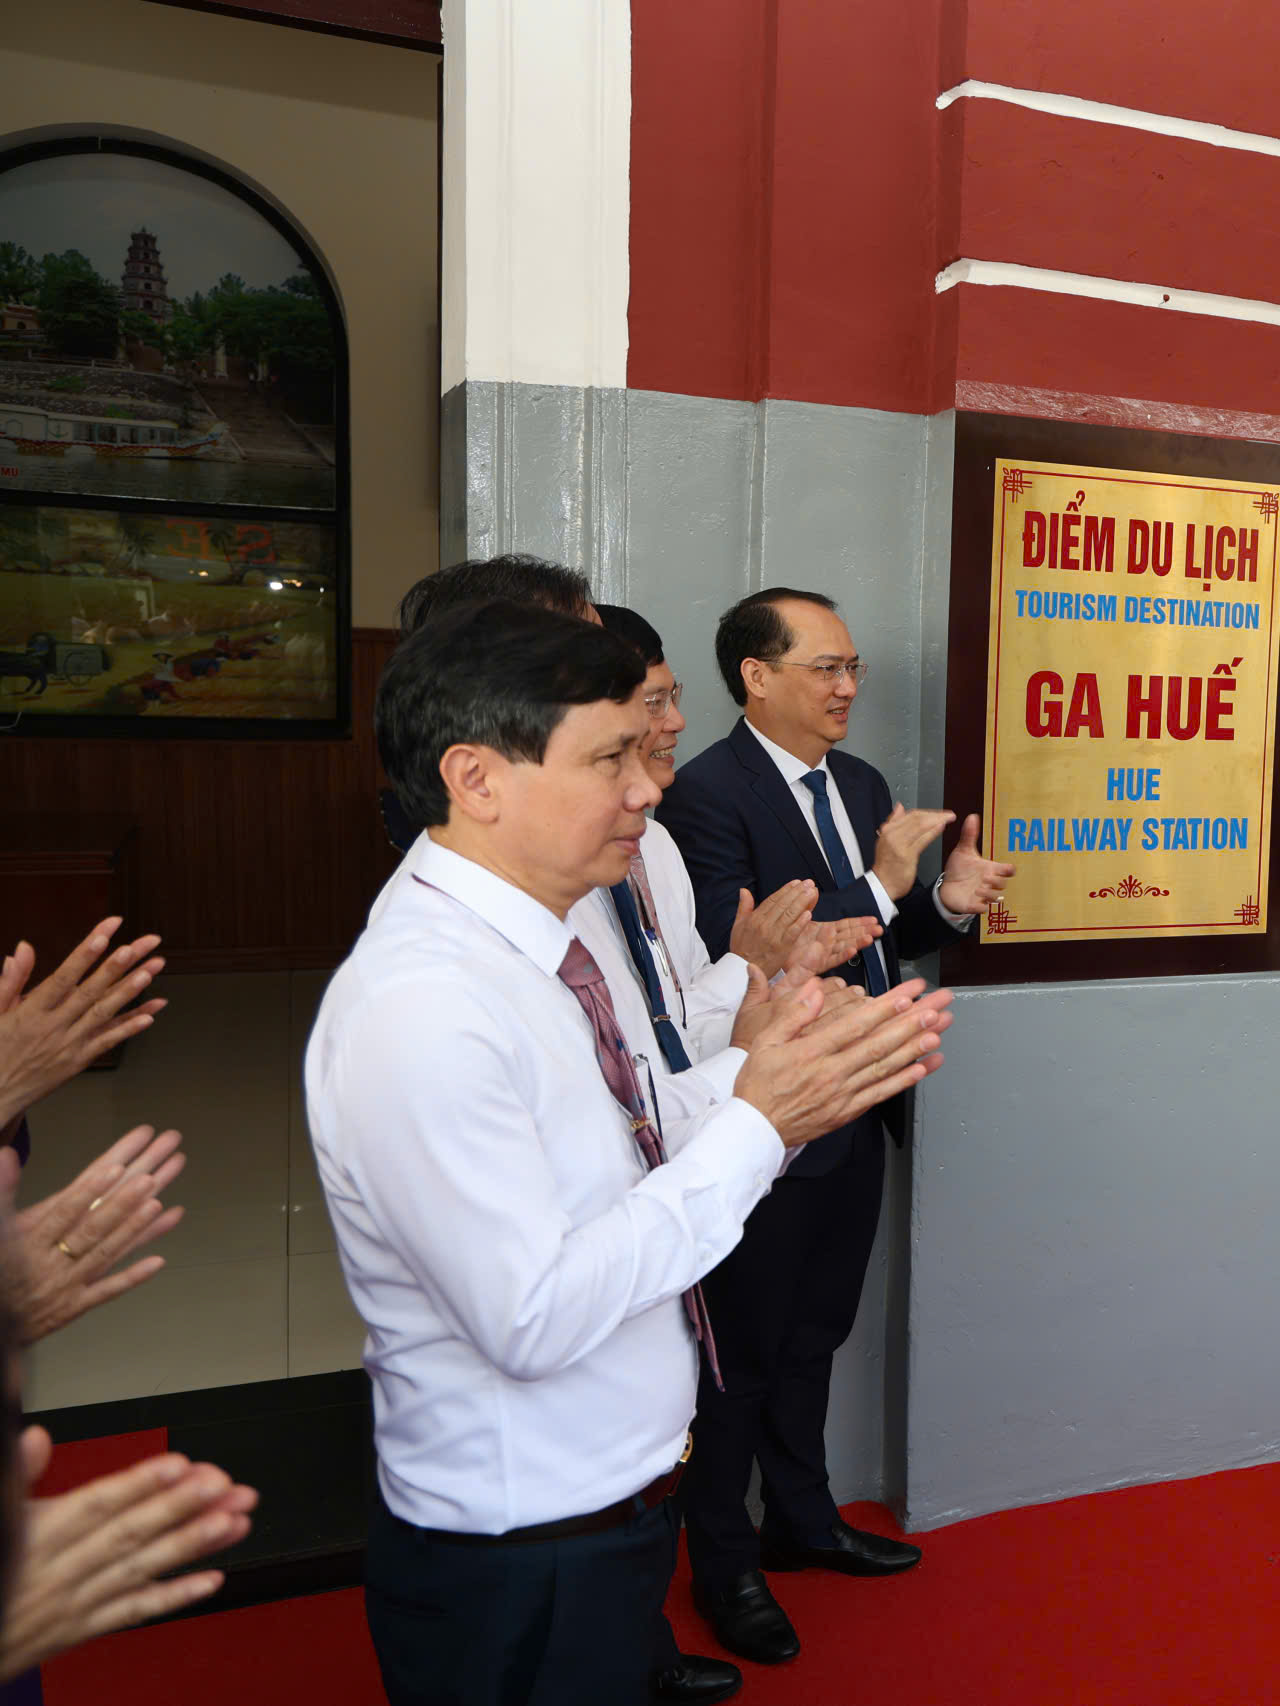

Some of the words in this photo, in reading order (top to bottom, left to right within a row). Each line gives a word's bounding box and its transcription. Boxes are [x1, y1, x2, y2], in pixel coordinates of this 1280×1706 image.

[1022, 490, 1115, 573] ĐIỂM
[1127, 518, 1174, 577] DU
[1184, 523, 1259, 592] LỊCH
[1015, 589, 1117, 622] TOURISM
[1124, 596, 1260, 629] DESTINATION
[1025, 670, 1105, 739] GA
[1125, 657, 1244, 741] HUẾ
[1106, 768, 1161, 801] HUE
[1007, 817, 1133, 852] RAILWAY
[1141, 817, 1248, 851] STATION
